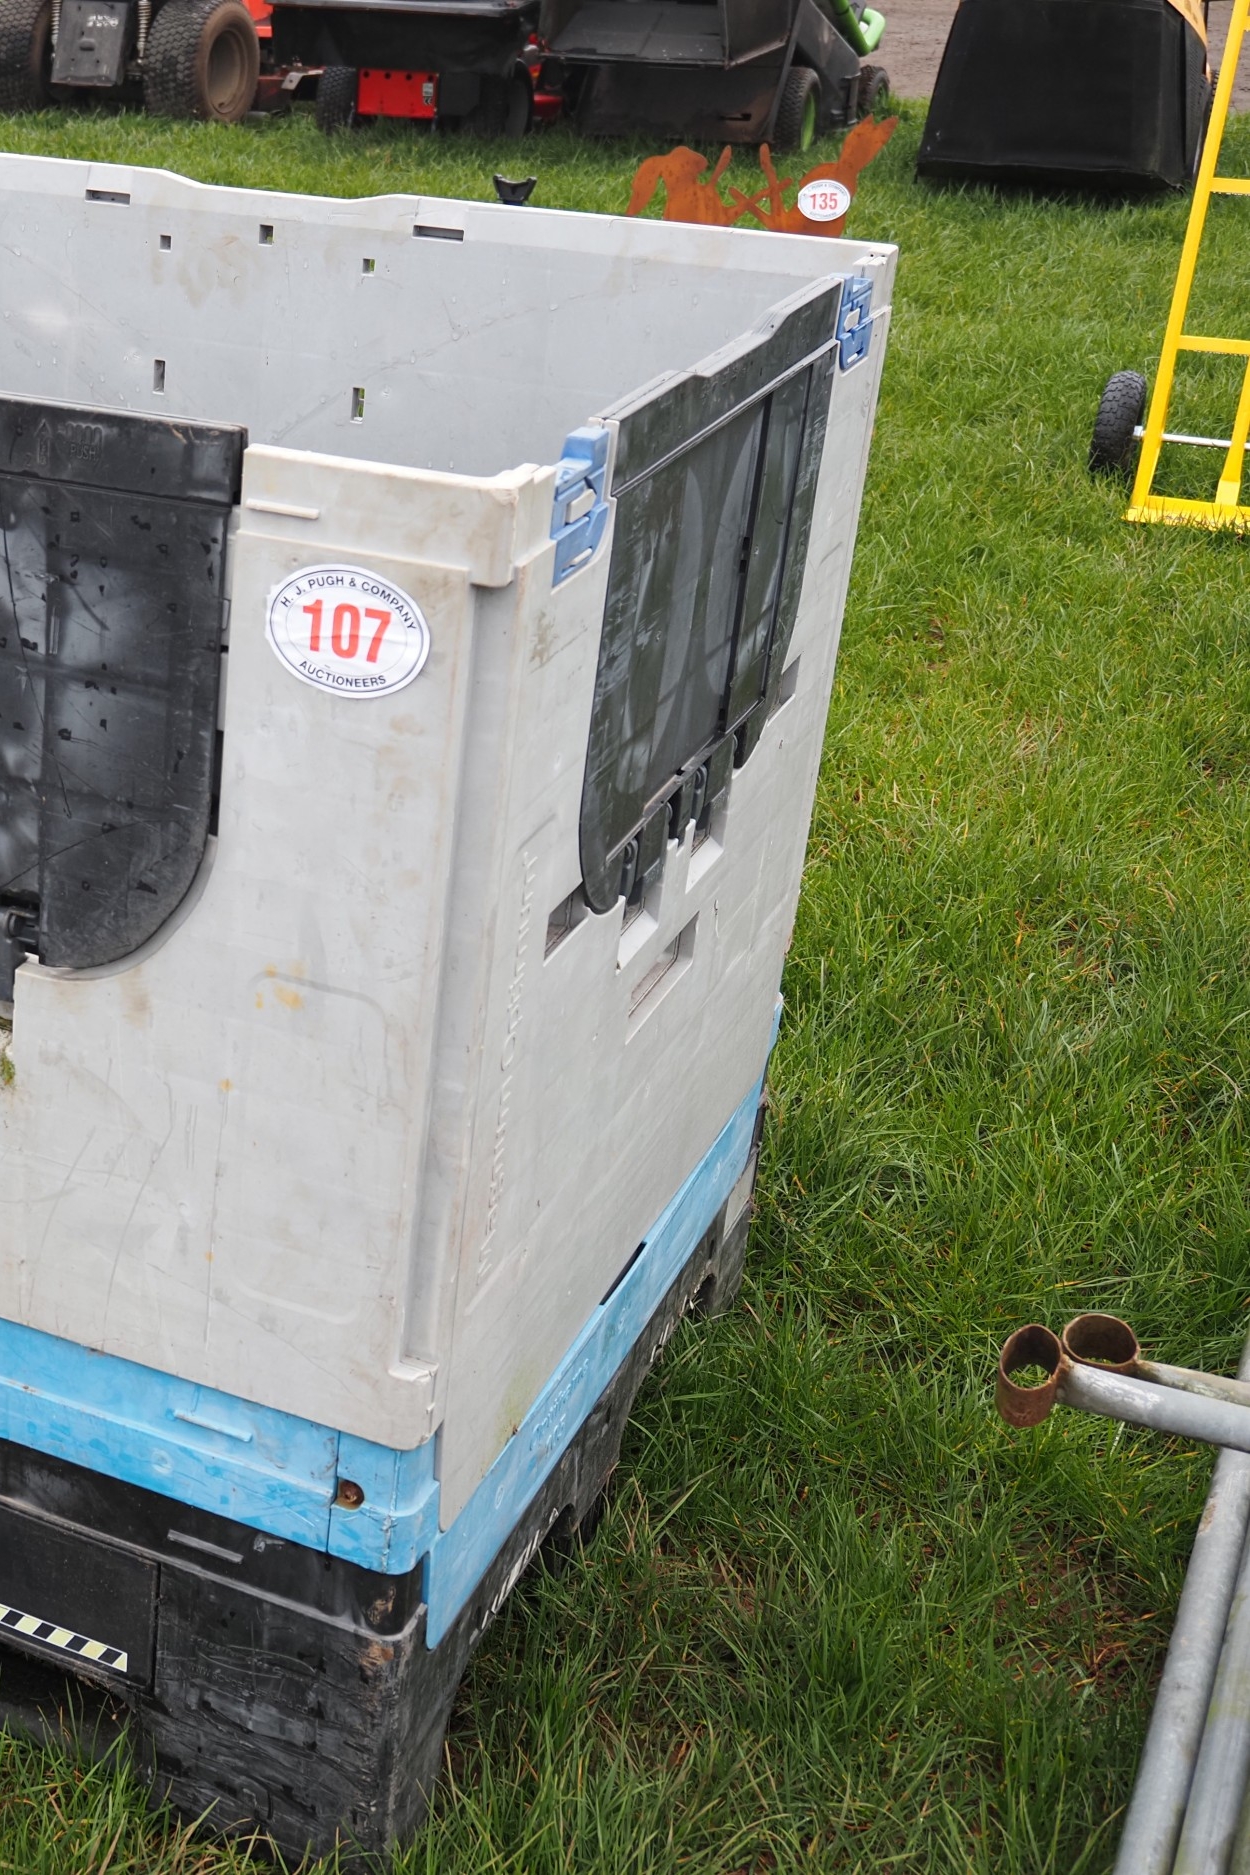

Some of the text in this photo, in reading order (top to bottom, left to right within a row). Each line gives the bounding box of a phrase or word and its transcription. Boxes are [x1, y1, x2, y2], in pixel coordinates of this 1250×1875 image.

[809, 192, 838, 210] 135
[280, 575, 417, 631] H. J. PUGH & COMPANY
[302, 599, 392, 664] 107
[299, 660, 386, 688] AUCTIONEERS
